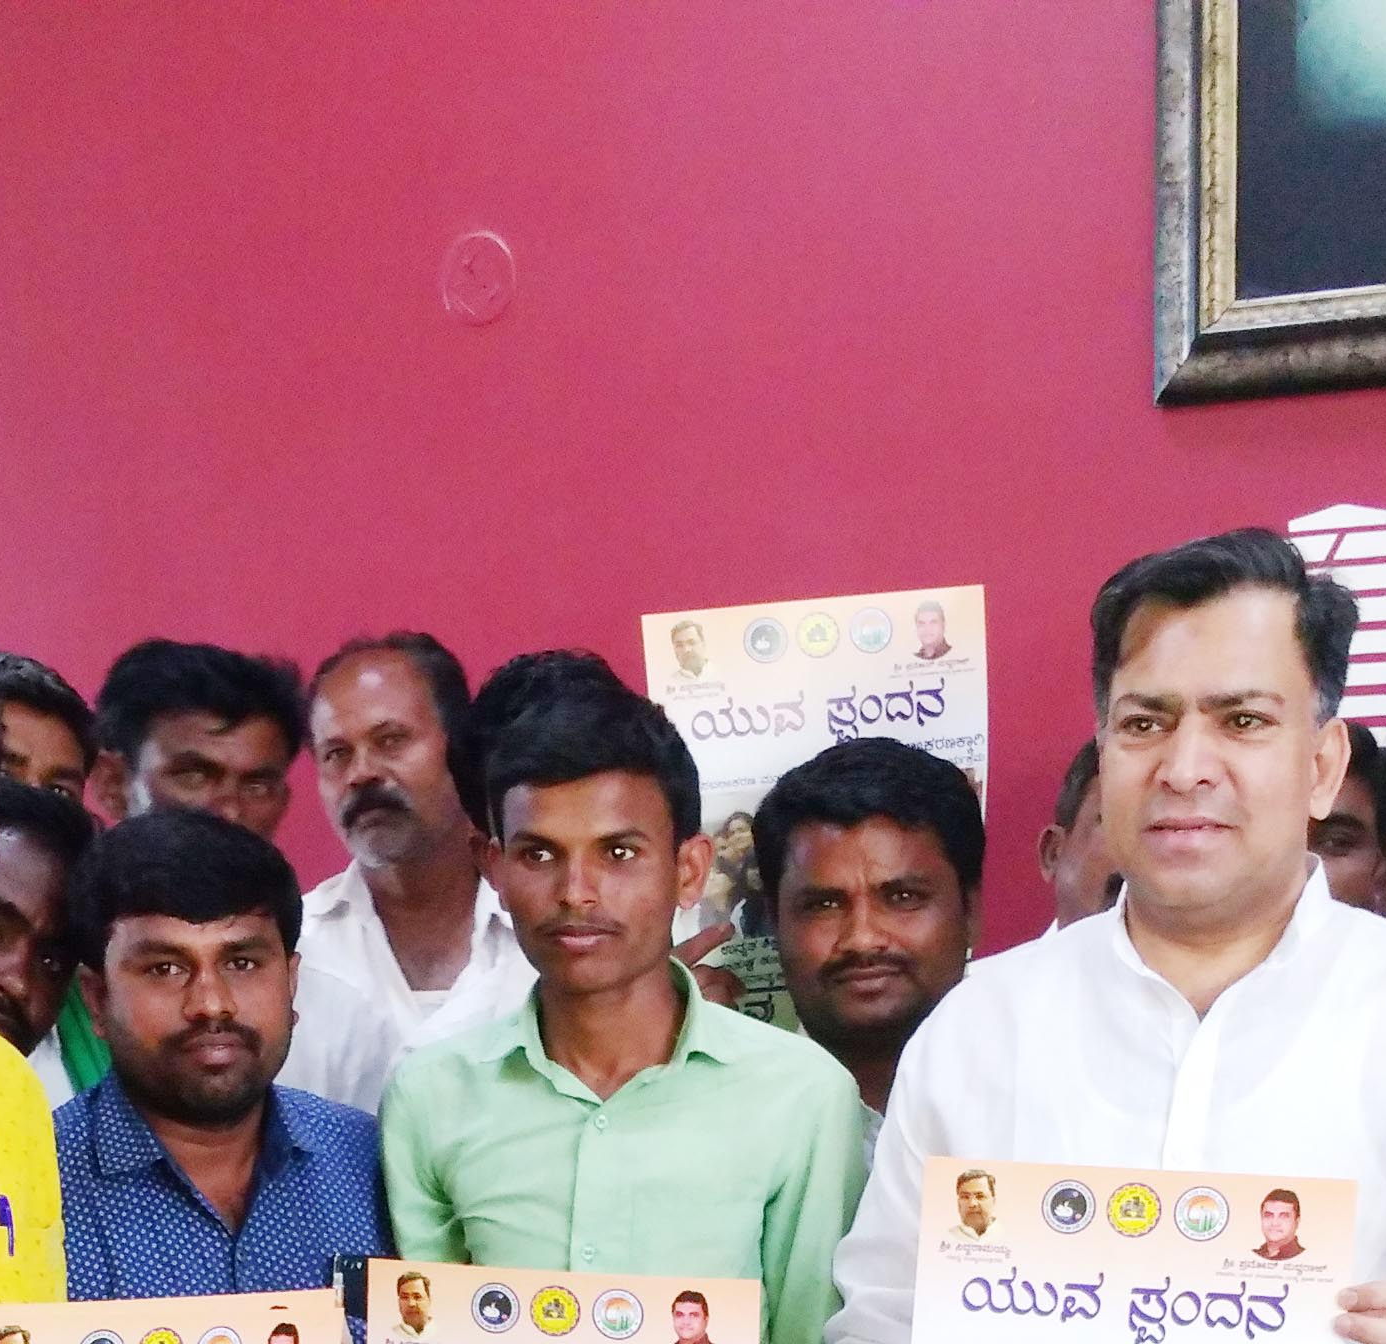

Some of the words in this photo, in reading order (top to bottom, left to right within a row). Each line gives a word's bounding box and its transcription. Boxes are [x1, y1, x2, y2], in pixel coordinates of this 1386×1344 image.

[691, 690, 804, 740] ಯುವ
[962, 1265, 1103, 1322] ಯುವ
[1127, 1276, 1289, 1344] ಸ್ಪಂದನ
